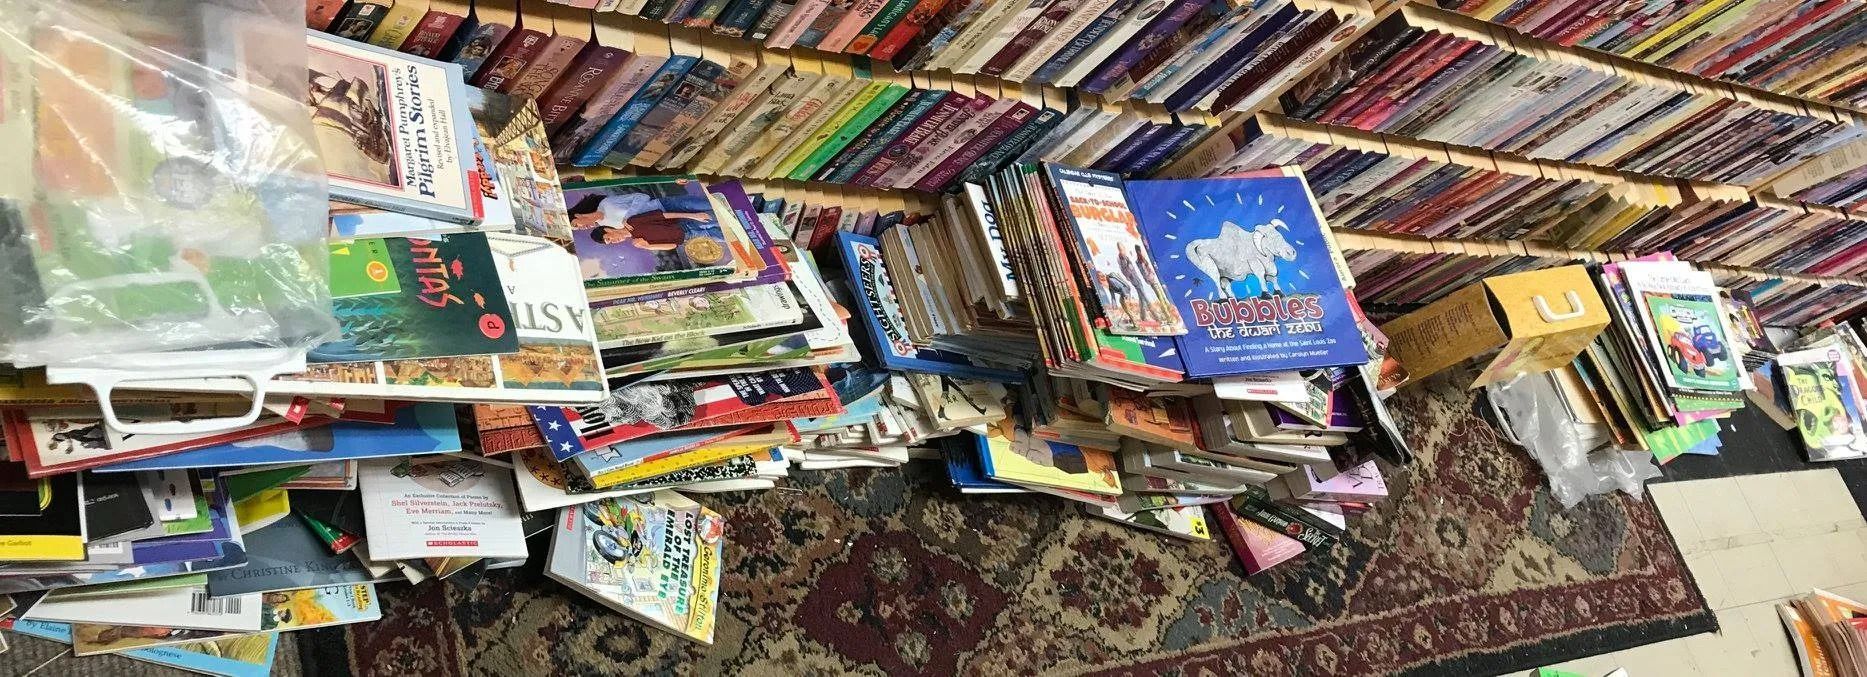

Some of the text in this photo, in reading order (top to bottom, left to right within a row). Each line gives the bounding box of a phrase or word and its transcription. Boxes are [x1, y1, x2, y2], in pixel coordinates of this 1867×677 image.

[427, 99, 439, 129] expanded
[438, 109, 446, 122] Hall
[391, 68, 415, 186] Margaret Pumphrey's
[405, 64, 435, 197] Pilgrim Stories
[434, 144, 443, 168] Revised
[446, 154, 452, 162] by
[597, 277, 629, 287] Summer
[668, 289, 688, 298] BEVERLY
[689, 287, 706, 295] CLEARY
[774, 285, 790, 310] drawings
[860, 257, 901, 341] SIGHTSEERS
[1191, 295, 1323, 327] Bubbles
[1208, 318, 1322, 339] the dwarf zebu
[636, 337, 650, 345] New
[651, 335, 662, 343] Kid
[1242, 343, 1262, 351] Finding
[1289, 351, 1309, 359] Carolyn
[1310, 349, 1328, 357] Mueller
[664, 510, 675, 569] EMERALD
[671, 536, 682, 581] OF THE
[675, 513, 693, 613] LOST TREASURE
[231, 566, 298, 580] CHRISTINE
[360, 585, 370, 603] STEP
[697, 546, 712, 631] Geronimo Stilton
[39, 621, 67, 633] Elaine
